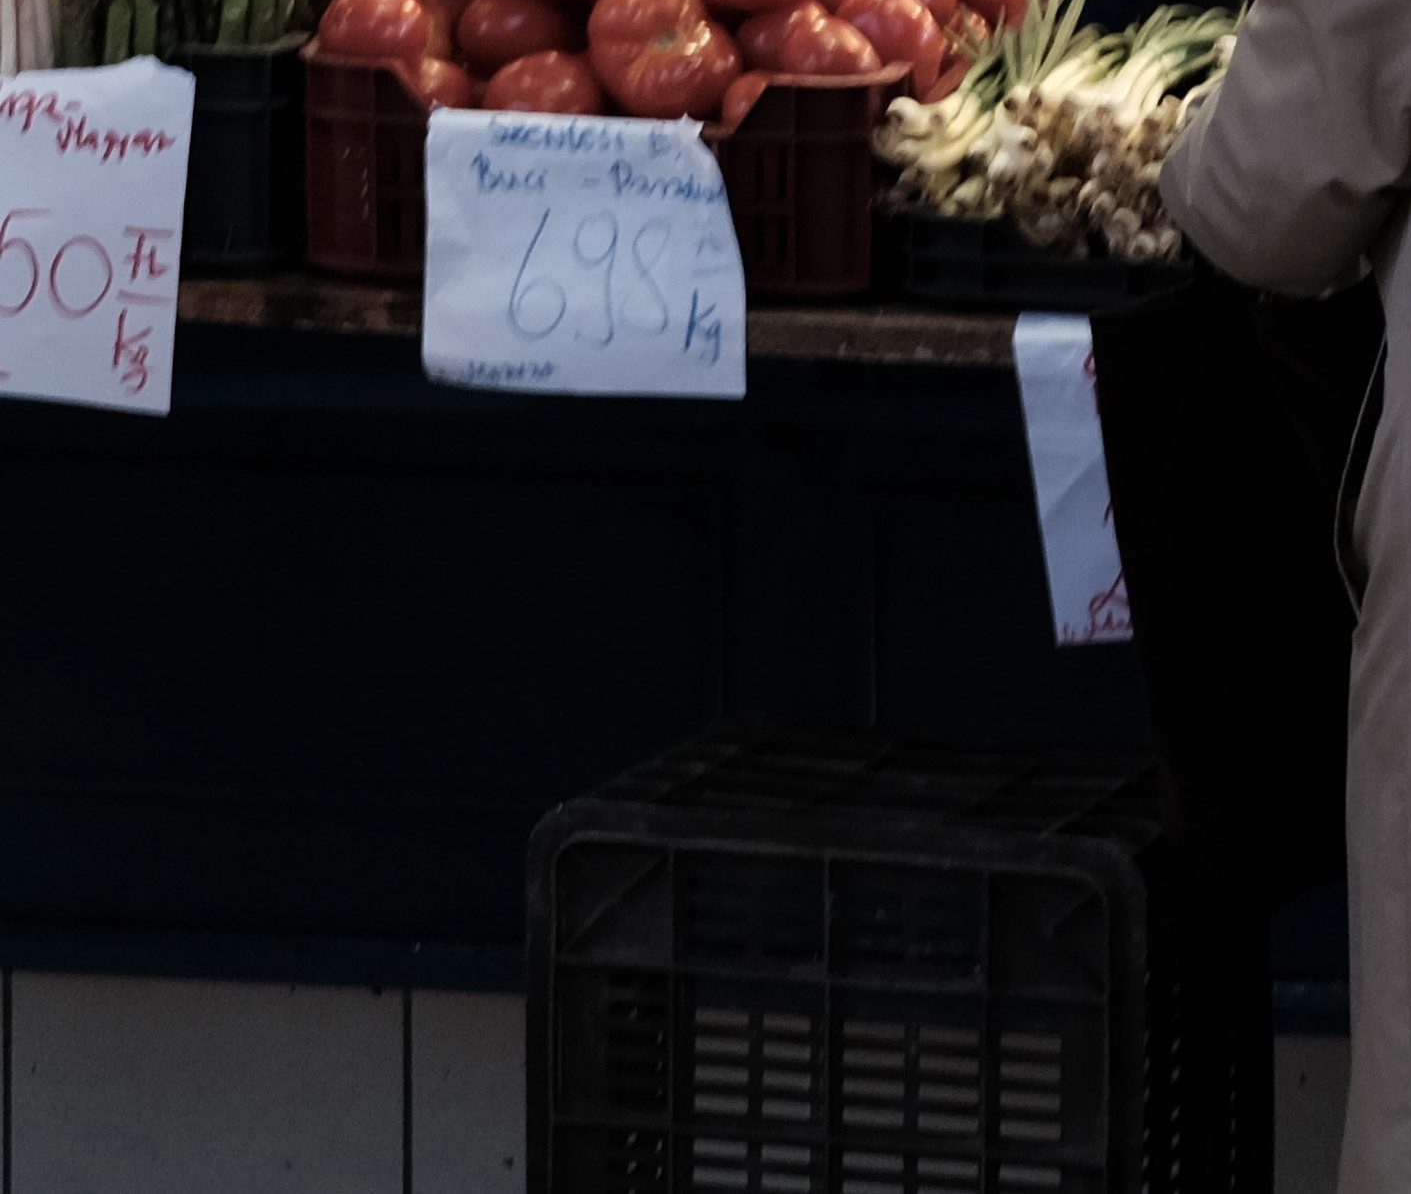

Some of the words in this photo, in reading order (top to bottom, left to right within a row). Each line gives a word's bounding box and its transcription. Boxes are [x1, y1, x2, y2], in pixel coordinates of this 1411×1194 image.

[56, 114, 177, 164] Magyar
[123, 225, 175, 283] Ft
[507, 206, 670, 349] 698
